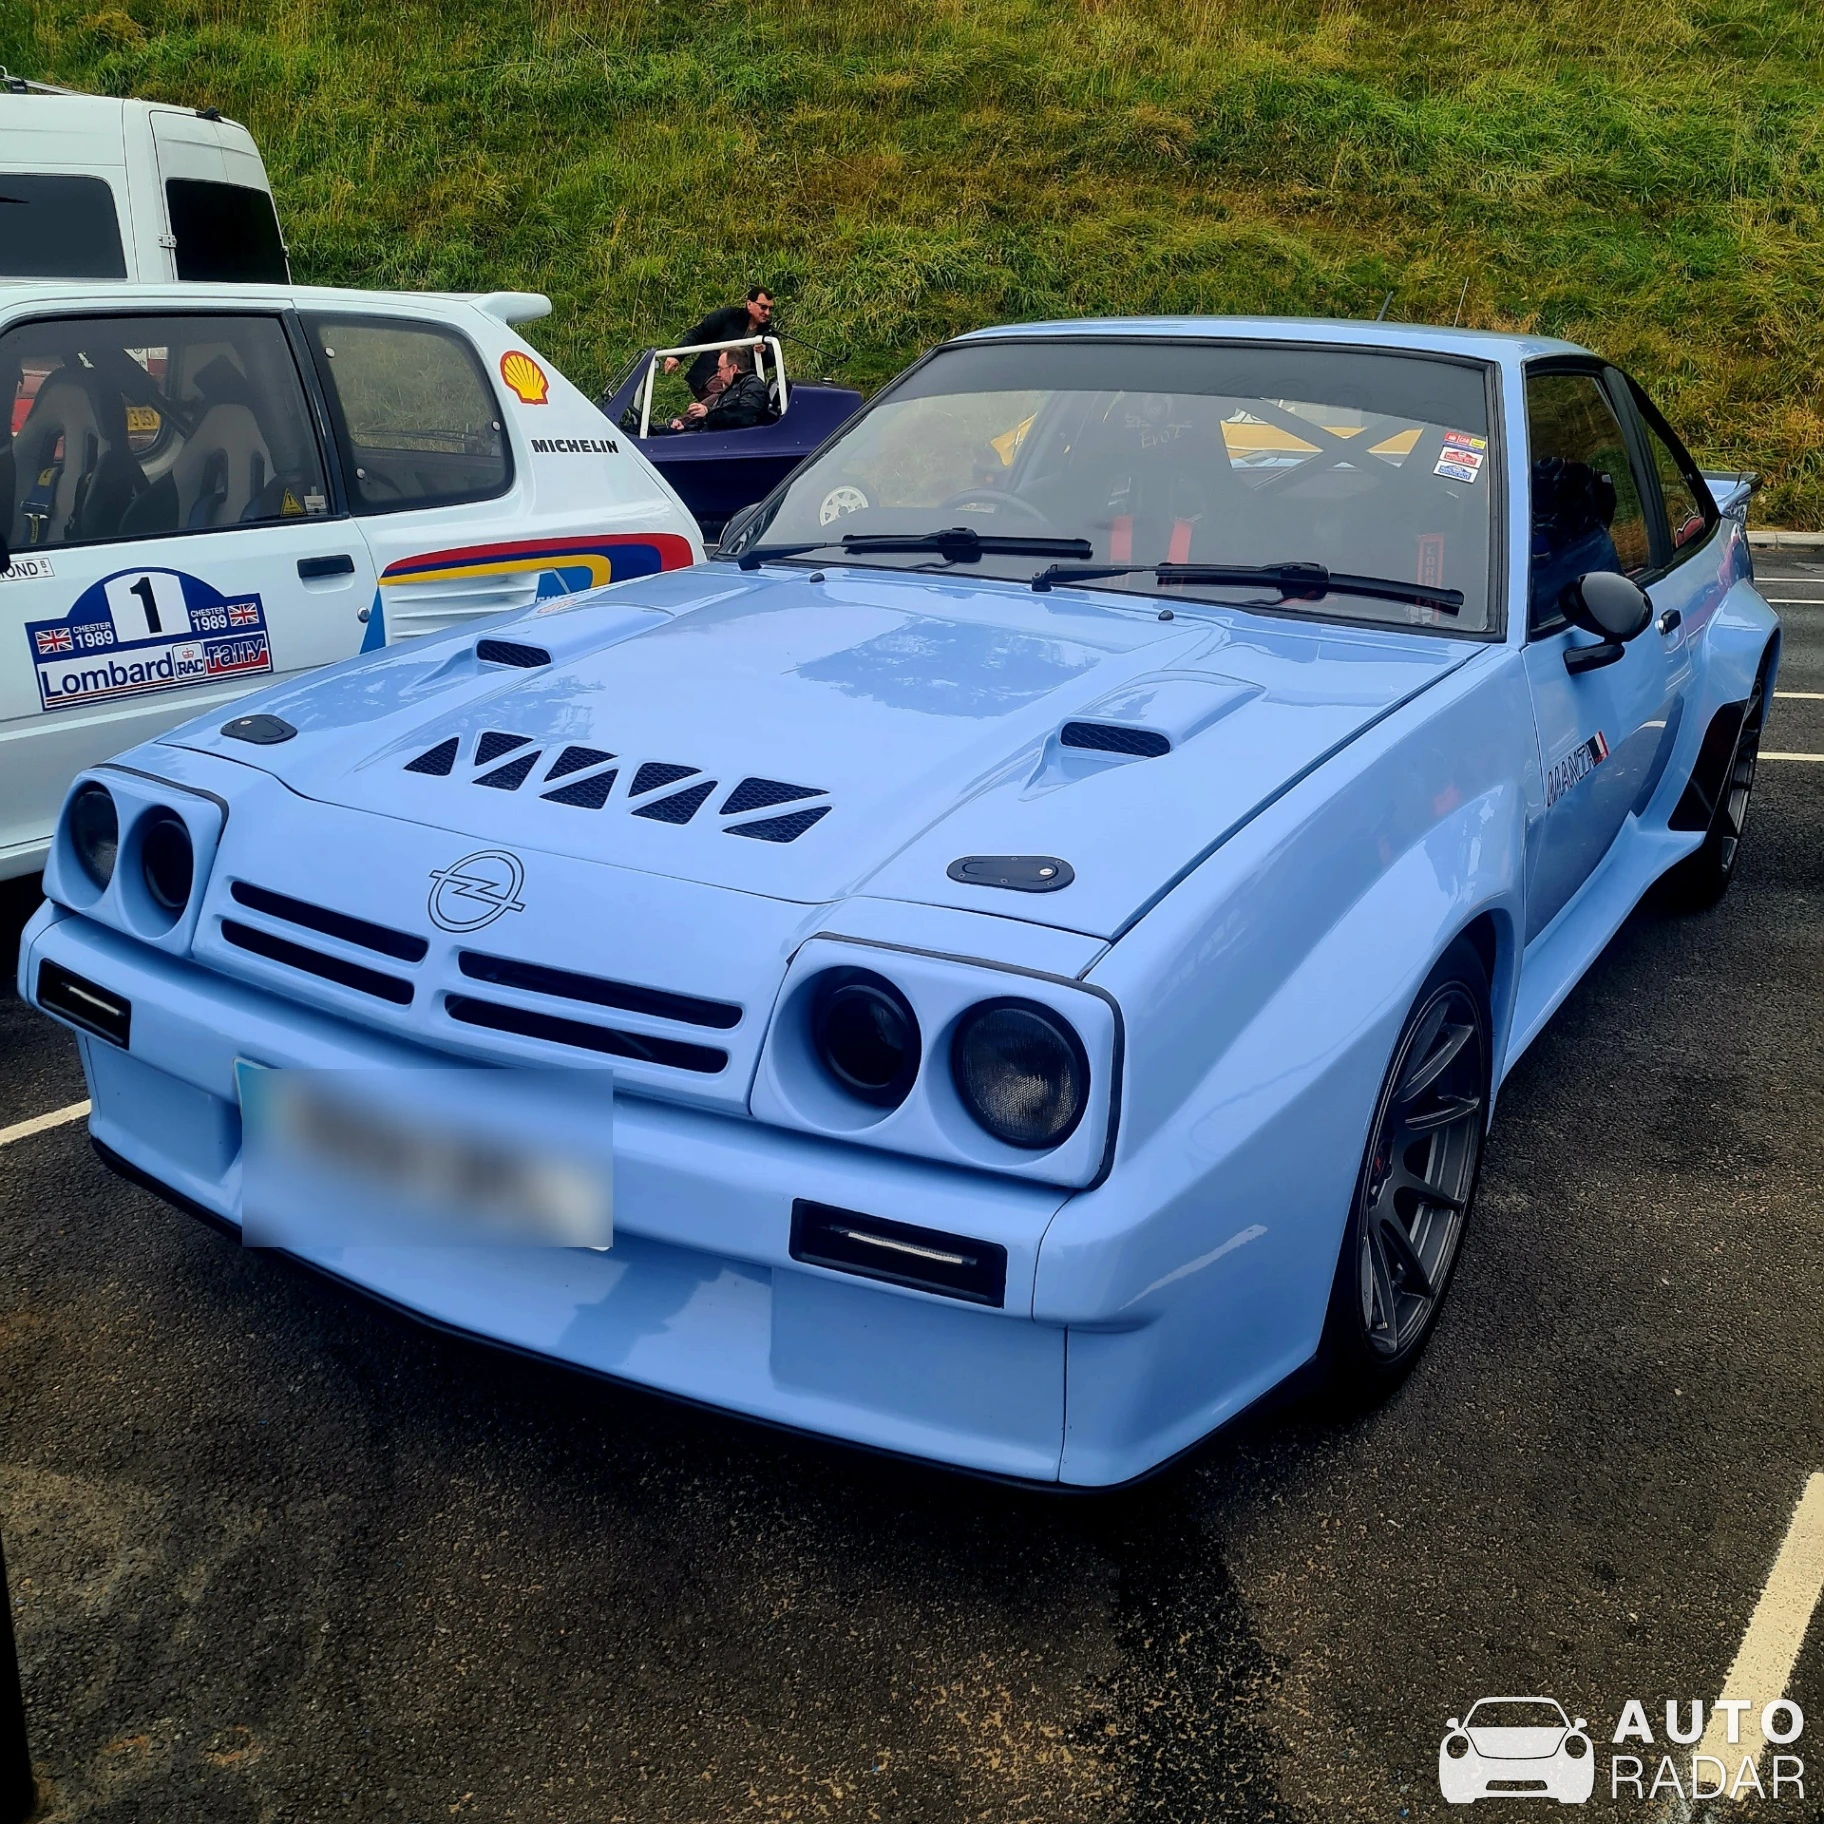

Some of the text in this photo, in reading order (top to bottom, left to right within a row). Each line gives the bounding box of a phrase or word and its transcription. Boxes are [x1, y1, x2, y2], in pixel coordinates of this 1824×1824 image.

[530, 439, 620, 454] MICHELIN
[1, 561, 39, 579] OND
[129, 576, 163, 634] 1
[190, 606, 225, 618] CHESTER
[72, 621, 112, 634] CHESTER
[192, 614, 228, 632] 1989
[75, 630, 114, 648] 1989
[41, 639, 265, 698] Lombard RAC rally
